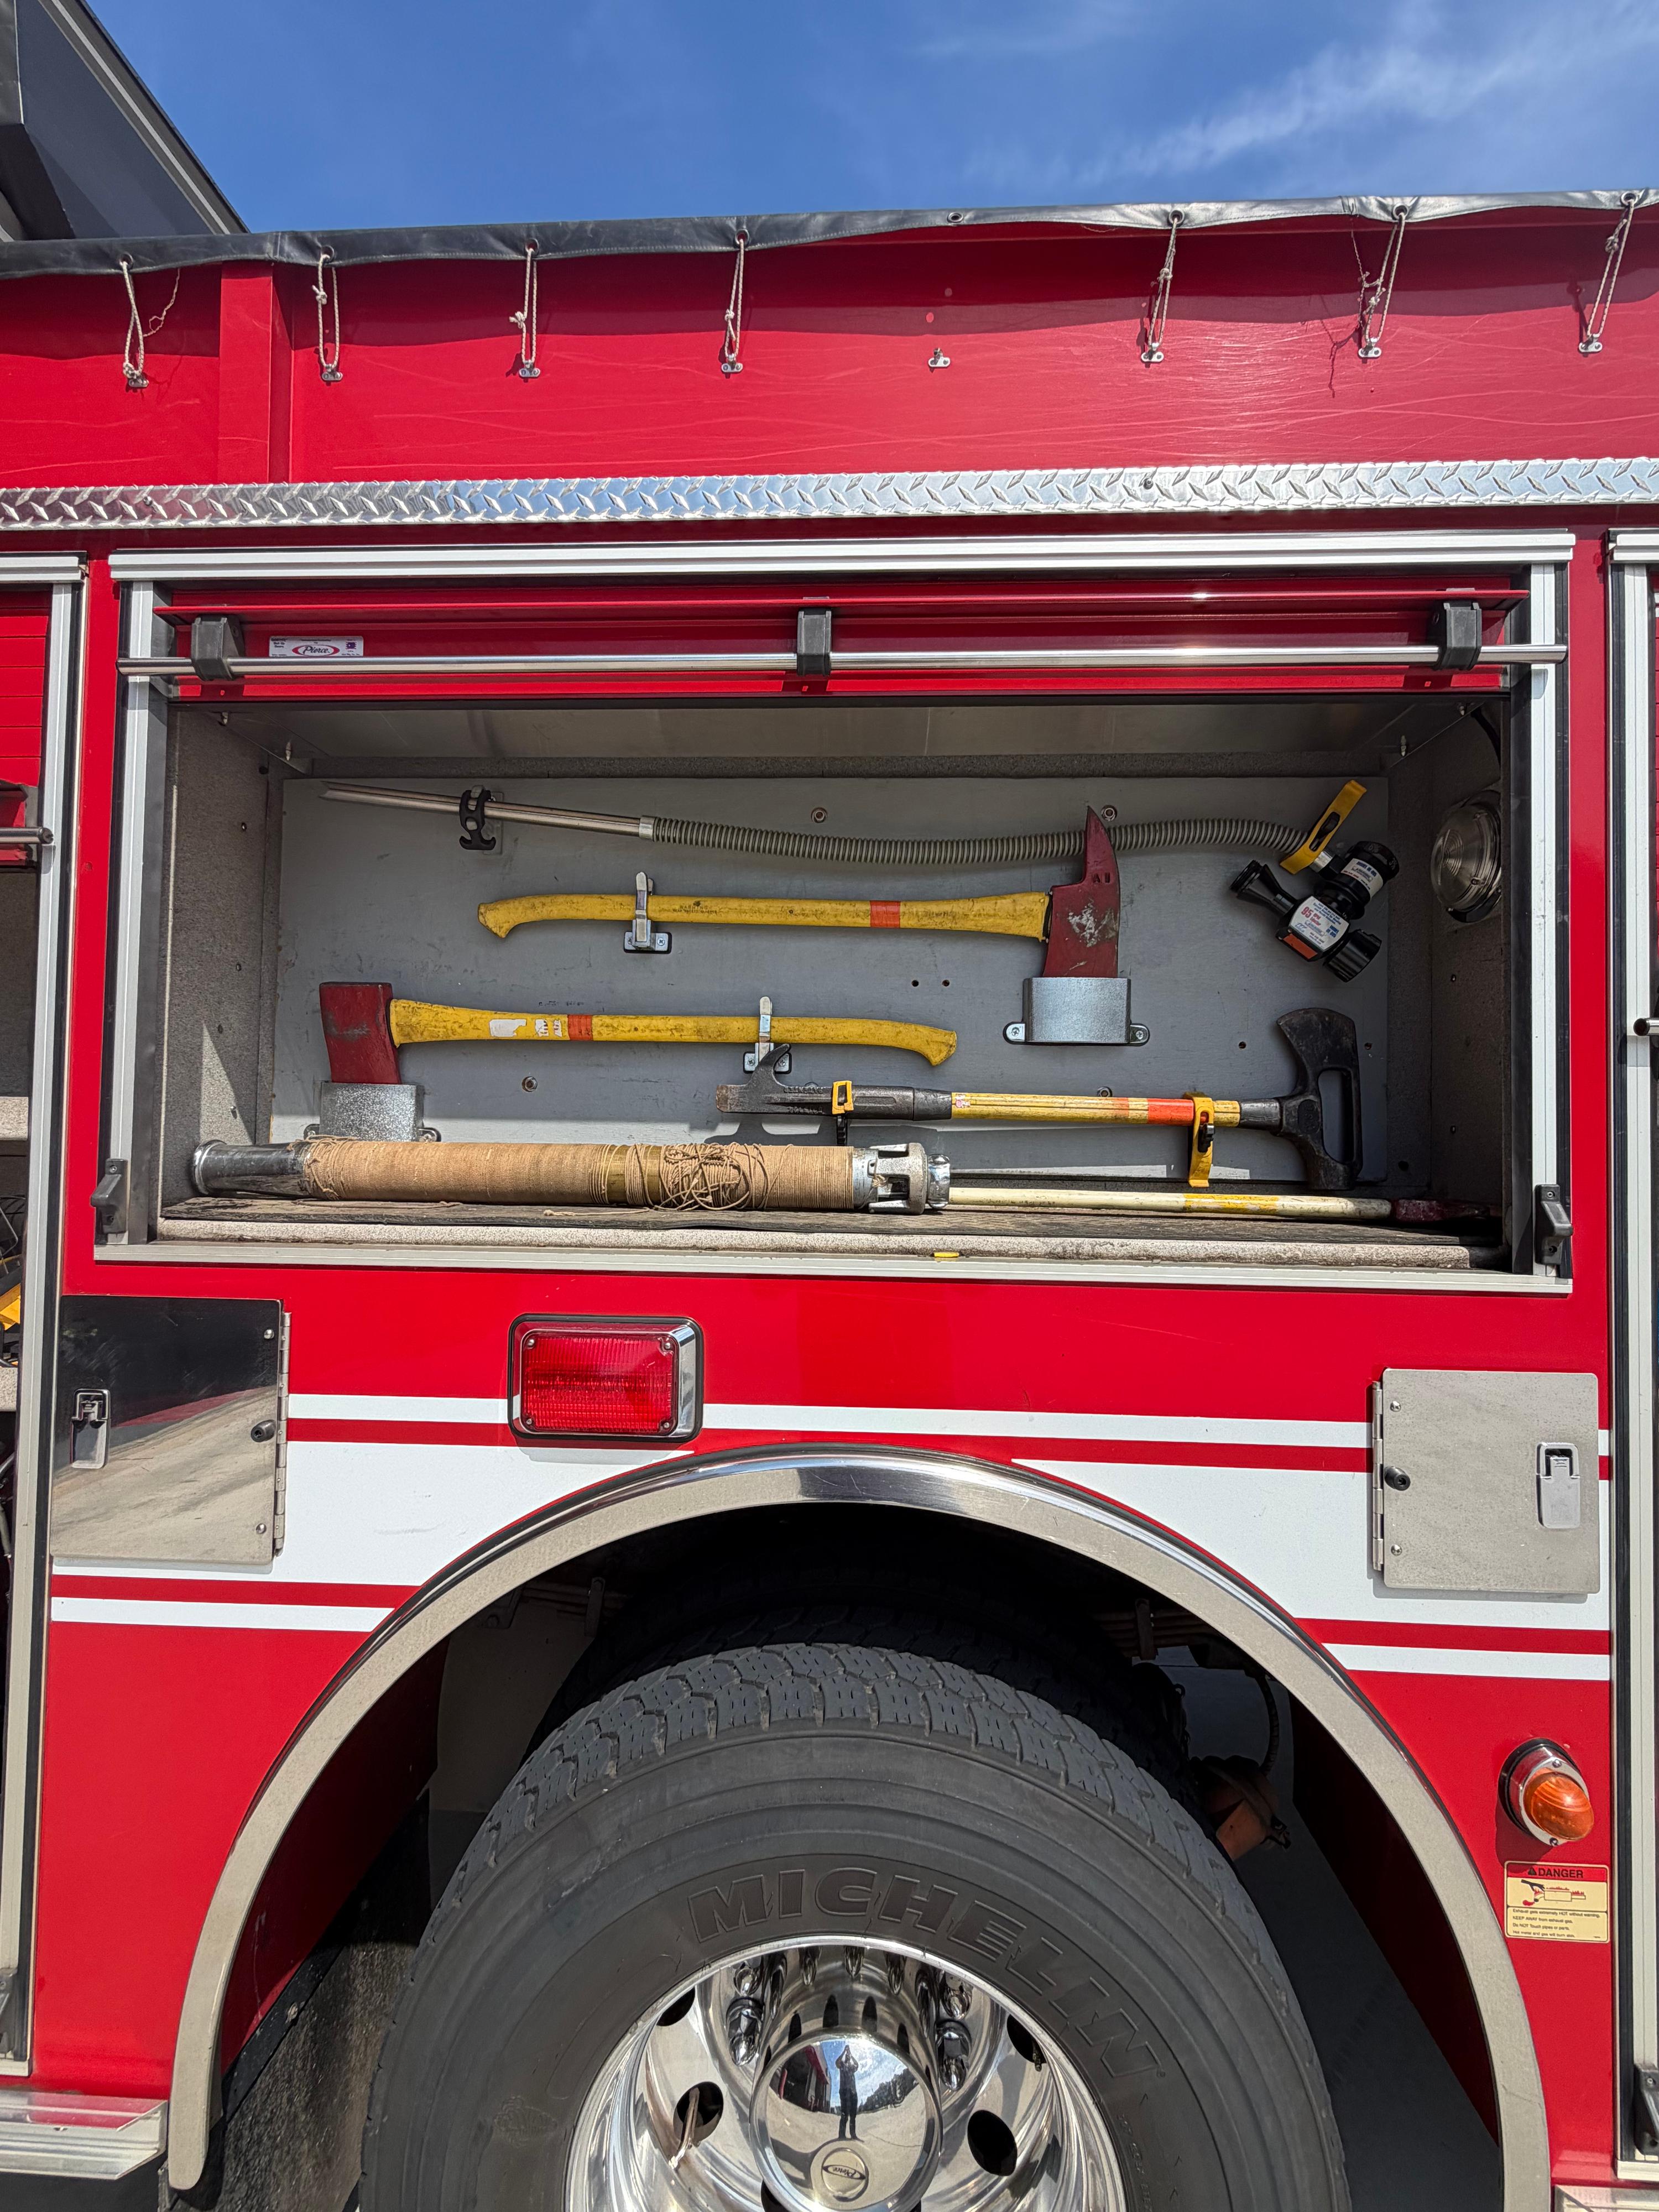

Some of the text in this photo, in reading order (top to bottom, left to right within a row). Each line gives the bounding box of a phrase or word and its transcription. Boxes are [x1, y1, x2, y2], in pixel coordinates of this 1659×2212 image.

[303, 645, 328, 654] Pierce
[1538, 1868, 1583, 1878] DANGER
[688, 1867, 1159, 2078] MICHELIN
